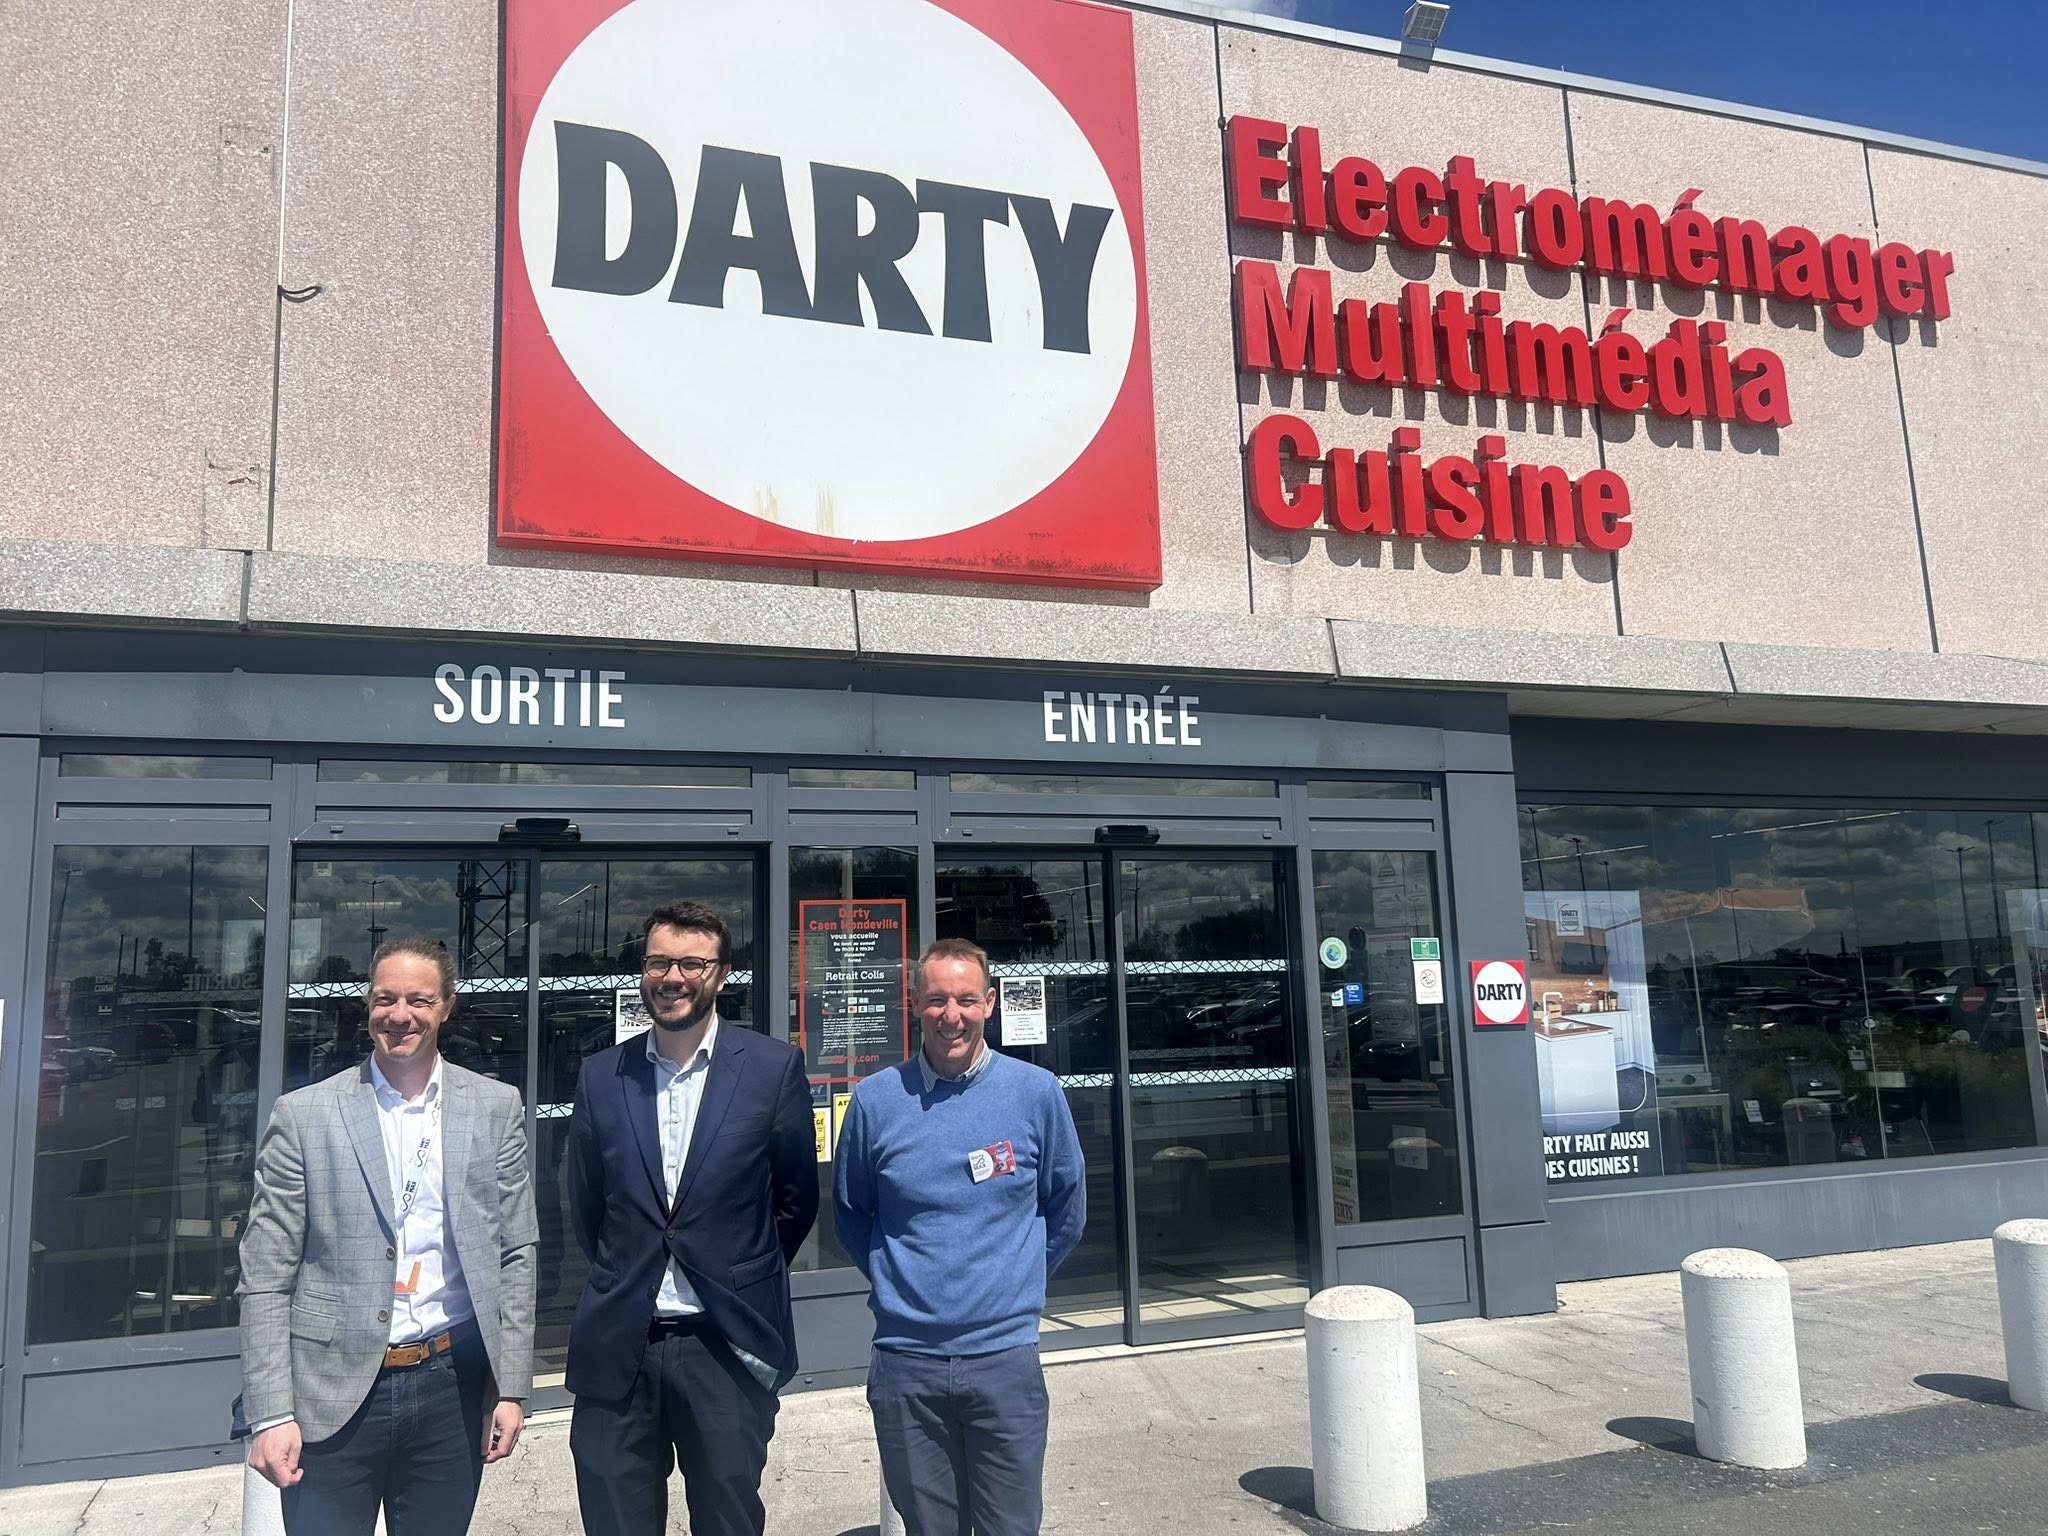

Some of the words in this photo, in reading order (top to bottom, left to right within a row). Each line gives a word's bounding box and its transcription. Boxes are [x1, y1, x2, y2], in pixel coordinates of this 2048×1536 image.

[552, 119, 1115, 355] DARTY
[1226, 114, 1956, 331] Electroménager
[1234, 259, 1793, 428] Multimédia
[1246, 413, 1633, 552] Cuisine
[432, 663, 627, 728] SORTIE
[1042, 684, 1202, 746] ENTRÉE
[809, 920, 837, 931] Caen
[849, 931, 879, 940] accueille
[825, 970, 859, 981] Retrait
[860, 969, 885, 980] Colis
[1477, 983, 1522, 1001] DARTY
[1575, 1133, 1607, 1153] FAIT
[1610, 1130, 1650, 1151] AUSSI
[1568, 1155, 1631, 1178] CUISINES
[1632, 1155, 1640, 1174] !
